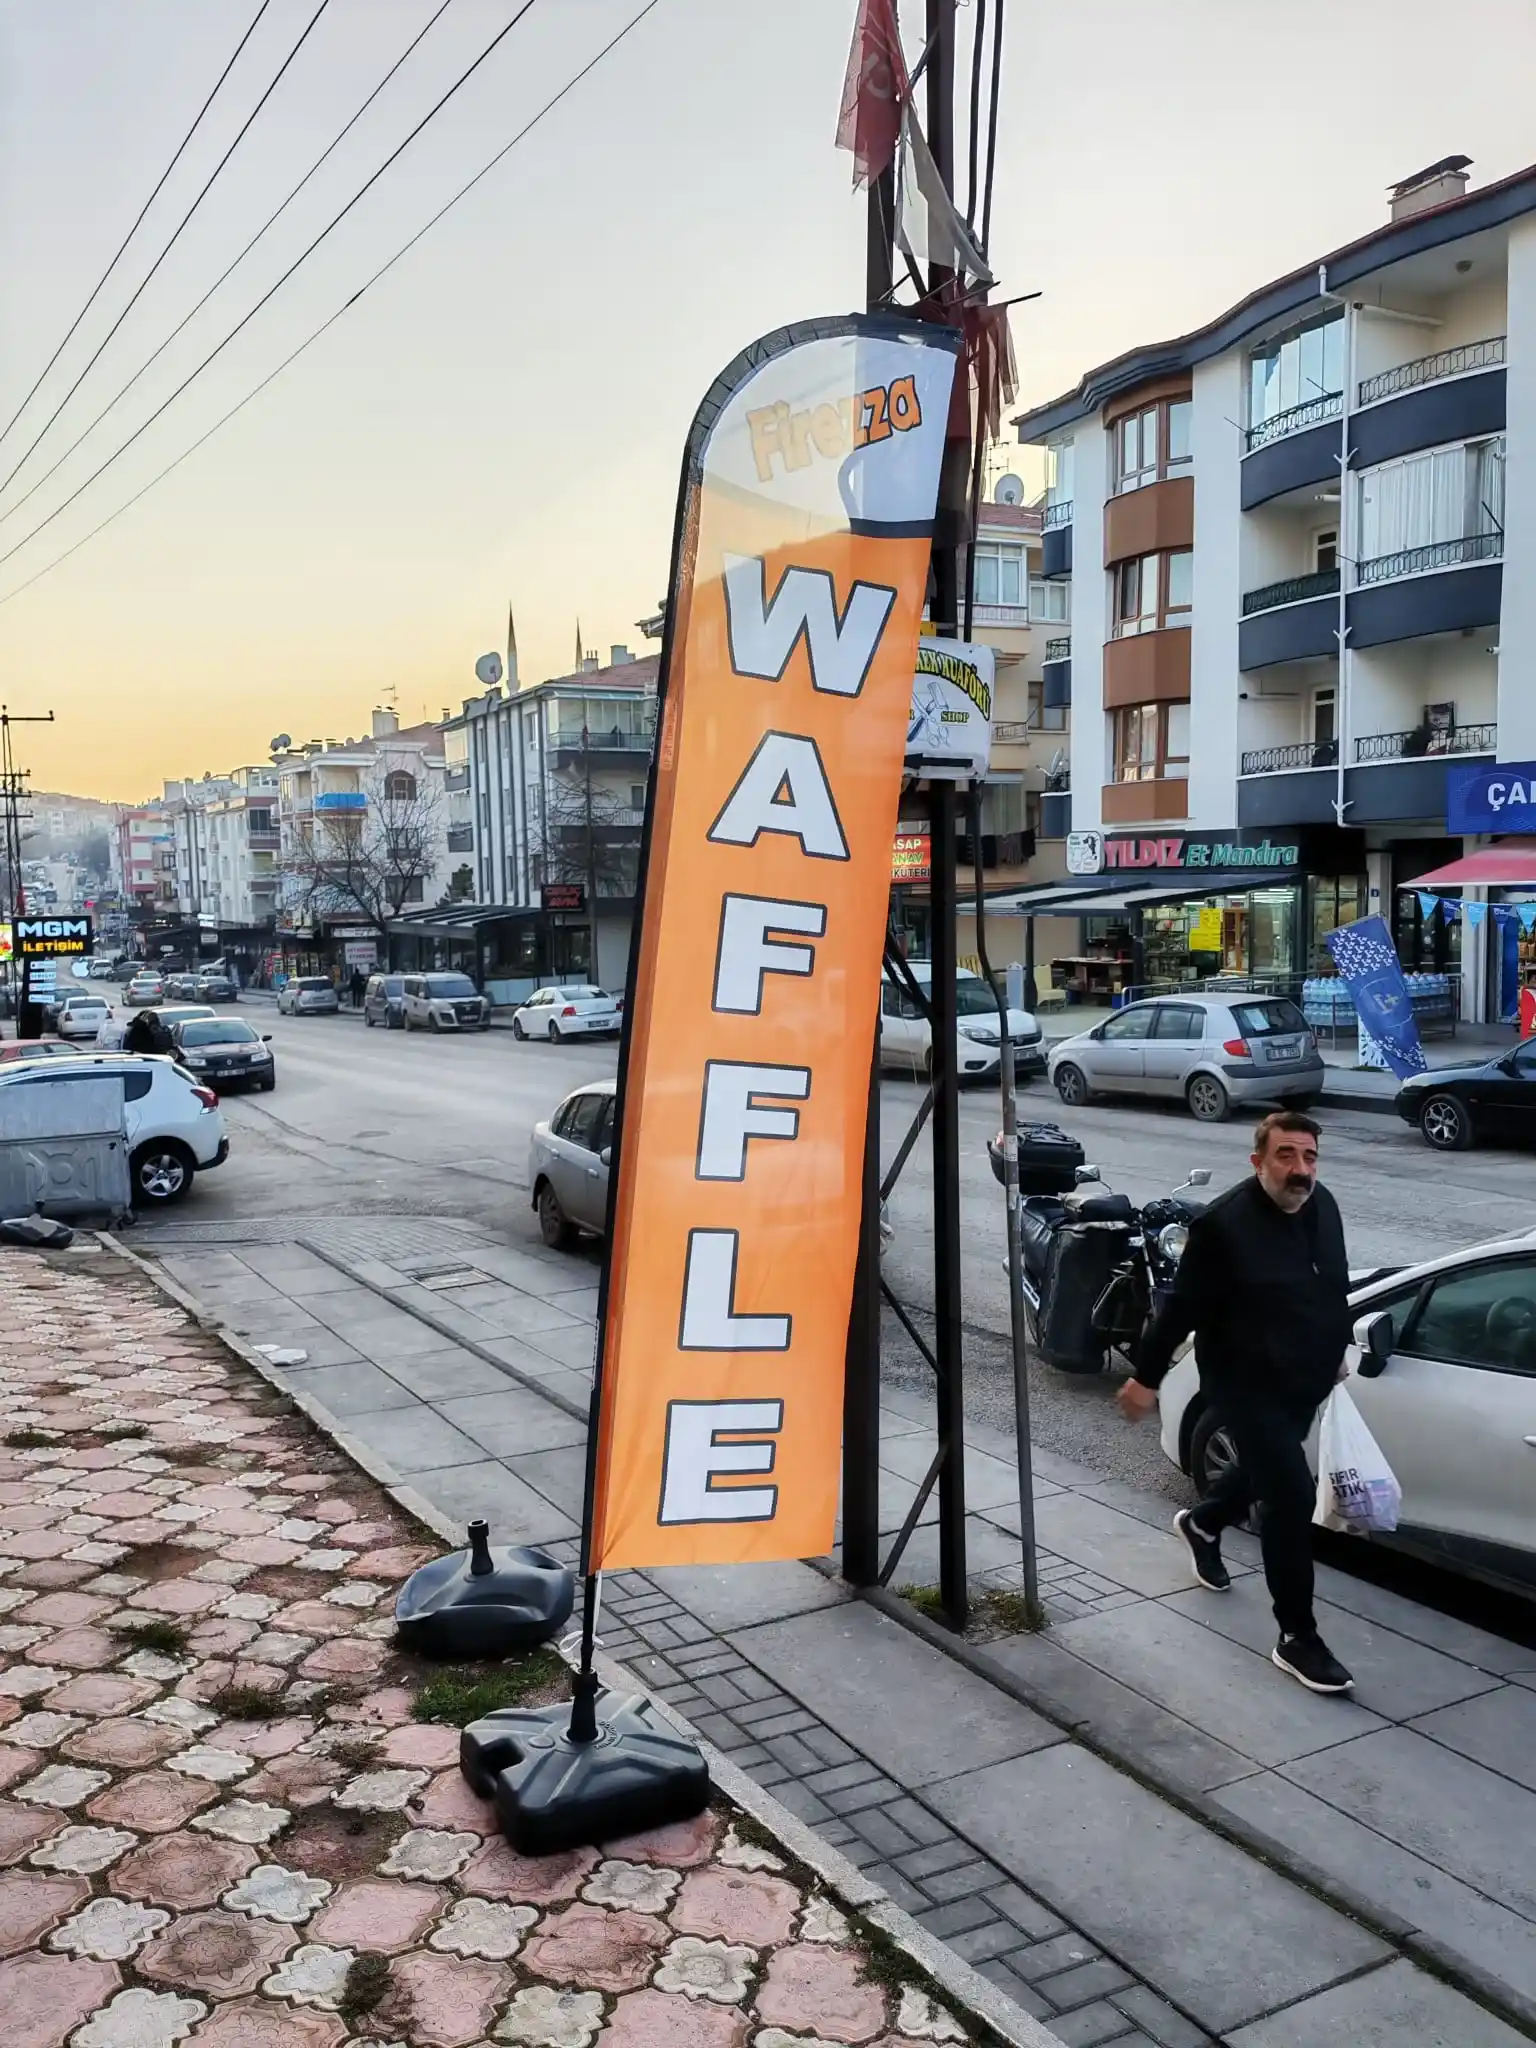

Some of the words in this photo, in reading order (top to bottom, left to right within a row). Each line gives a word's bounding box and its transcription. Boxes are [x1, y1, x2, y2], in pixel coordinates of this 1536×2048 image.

[746, 374, 922, 483] Firezza
[941, 710, 970, 724] SHOP
[1487, 781, 1536, 812] ÇA
[1104, 838, 1186, 868] YILDIZ
[1186, 843, 1210, 868] Et
[18, 920, 88, 938] MGM
[22, 939, 84, 952] İLETİŞİM
[656, 550, 898, 1527] WAFFLE
